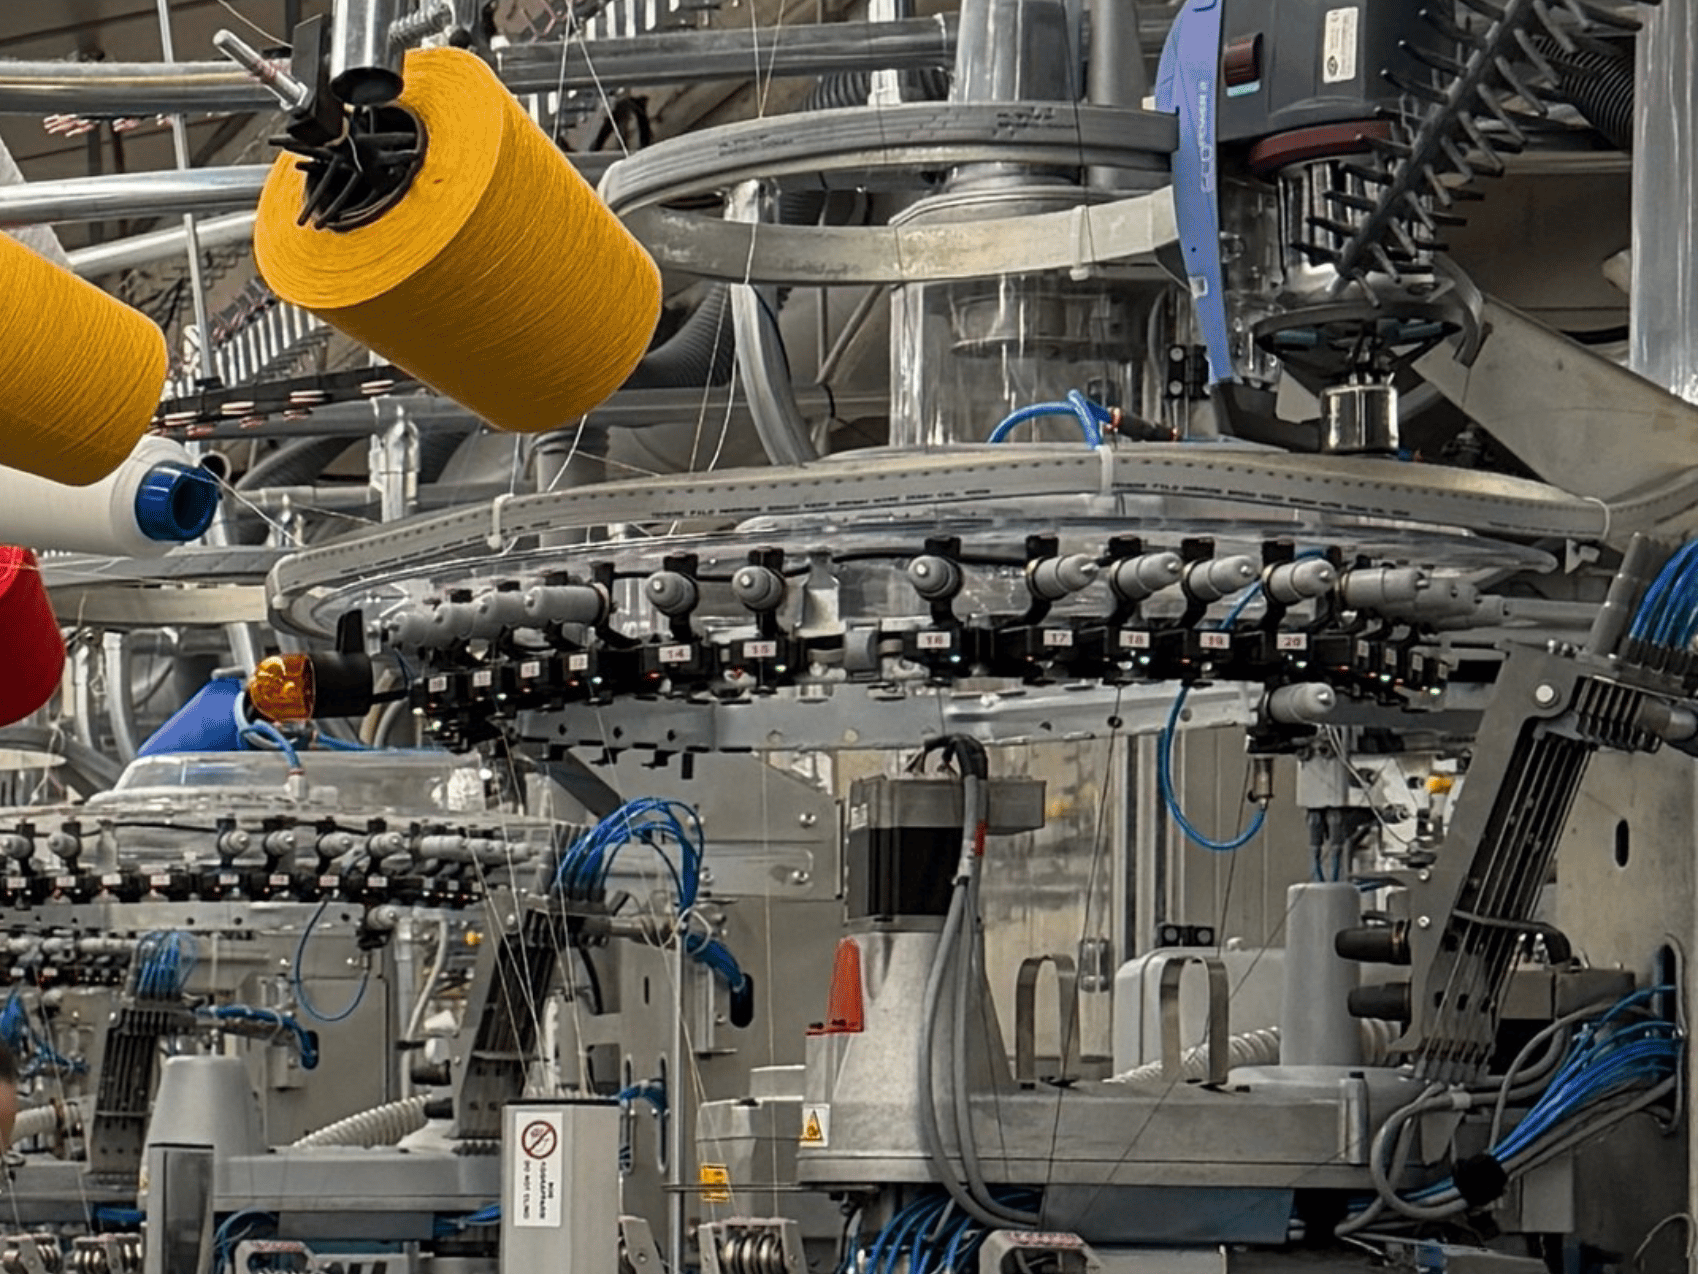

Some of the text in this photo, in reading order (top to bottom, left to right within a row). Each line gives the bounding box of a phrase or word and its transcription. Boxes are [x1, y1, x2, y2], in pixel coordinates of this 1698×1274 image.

[1051, 633, 1067, 643] 17
[1207, 635, 1223, 646] 19
[1284, 637, 1300, 647] 20
[667, 649, 685, 659] 14
